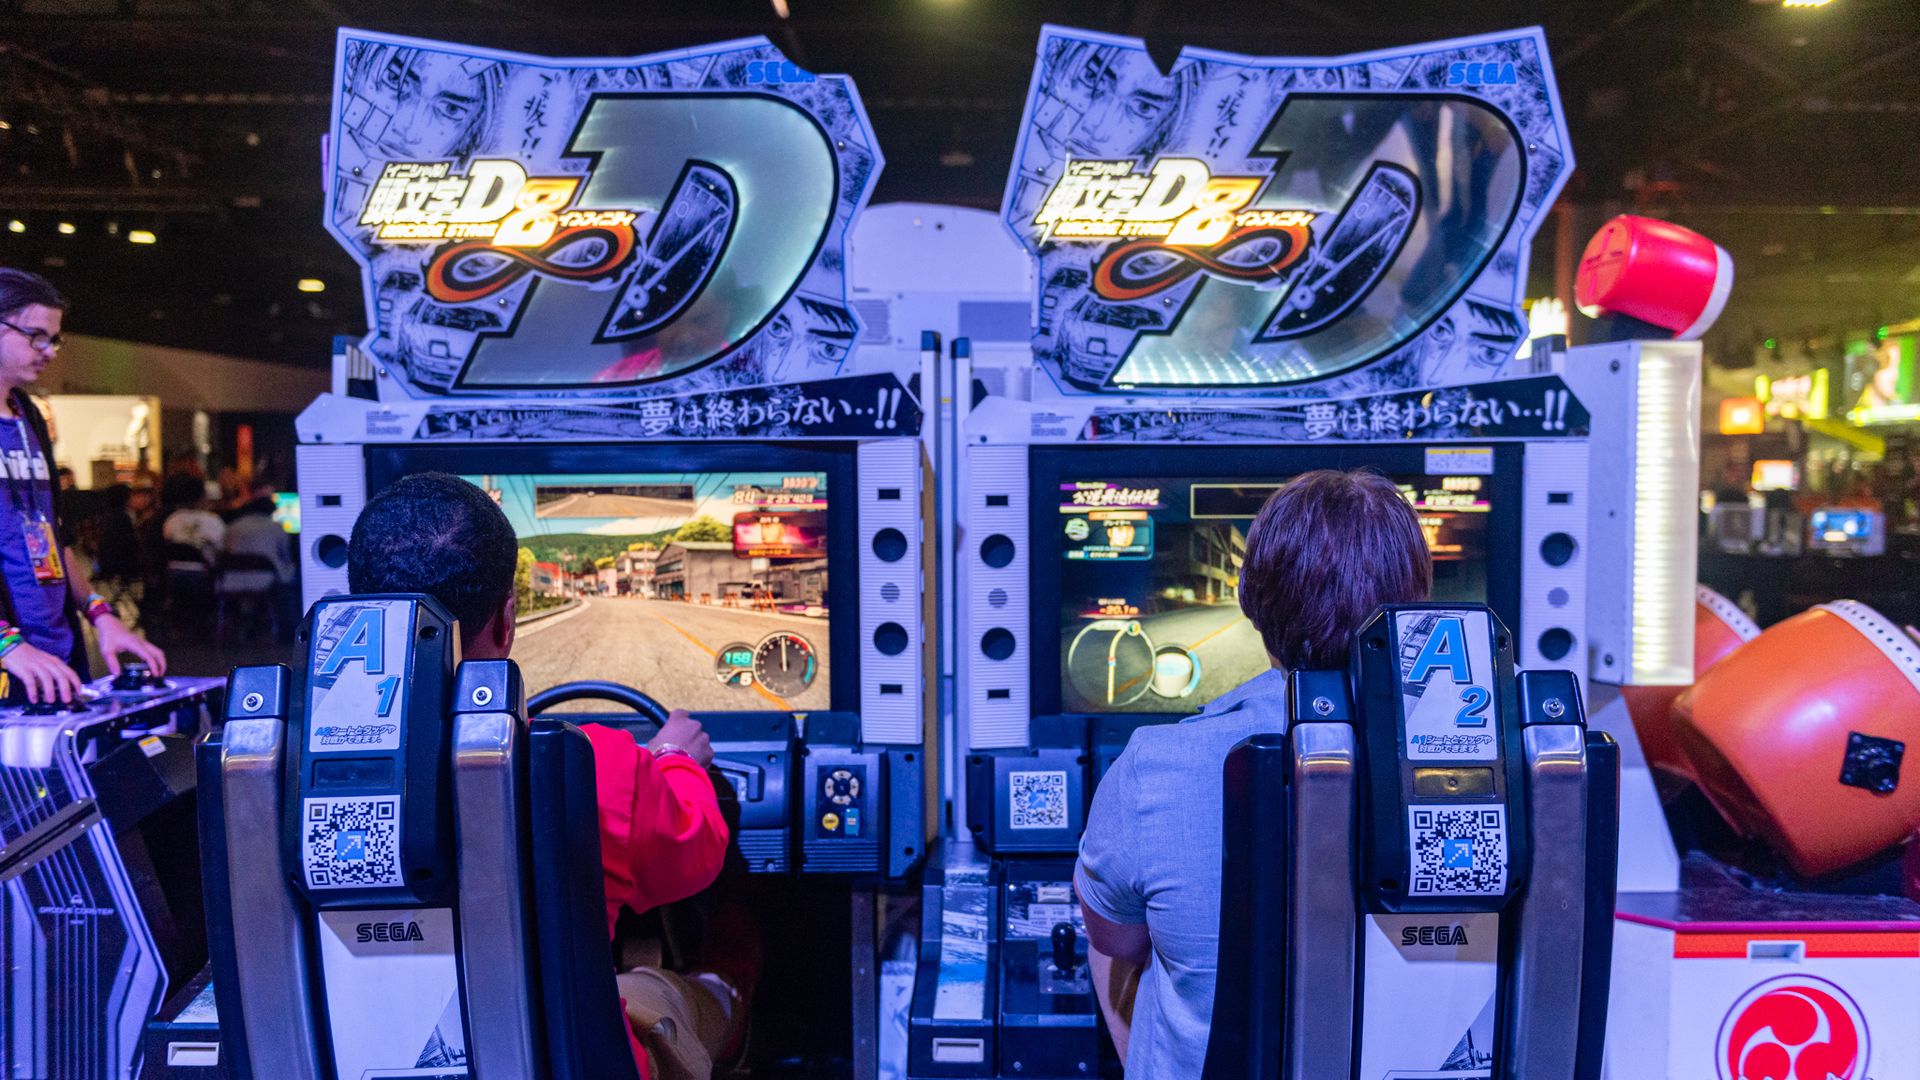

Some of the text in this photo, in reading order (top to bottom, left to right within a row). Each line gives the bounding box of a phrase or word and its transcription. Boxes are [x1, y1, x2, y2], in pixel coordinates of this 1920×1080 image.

[1448, 62, 1517, 84] SEGA
[380, 222, 500, 239] ARCADE STAGE
[1054, 220, 1175, 237] ARCADE STAGE
[317, 607, 385, 675] A
[1406, 617, 1473, 685] A
[375, 674, 400, 718] 1
[1454, 685, 1492, 728] 2
[356, 921, 424, 943] SEGA
[1401, 926, 1468, 946] SEGA
